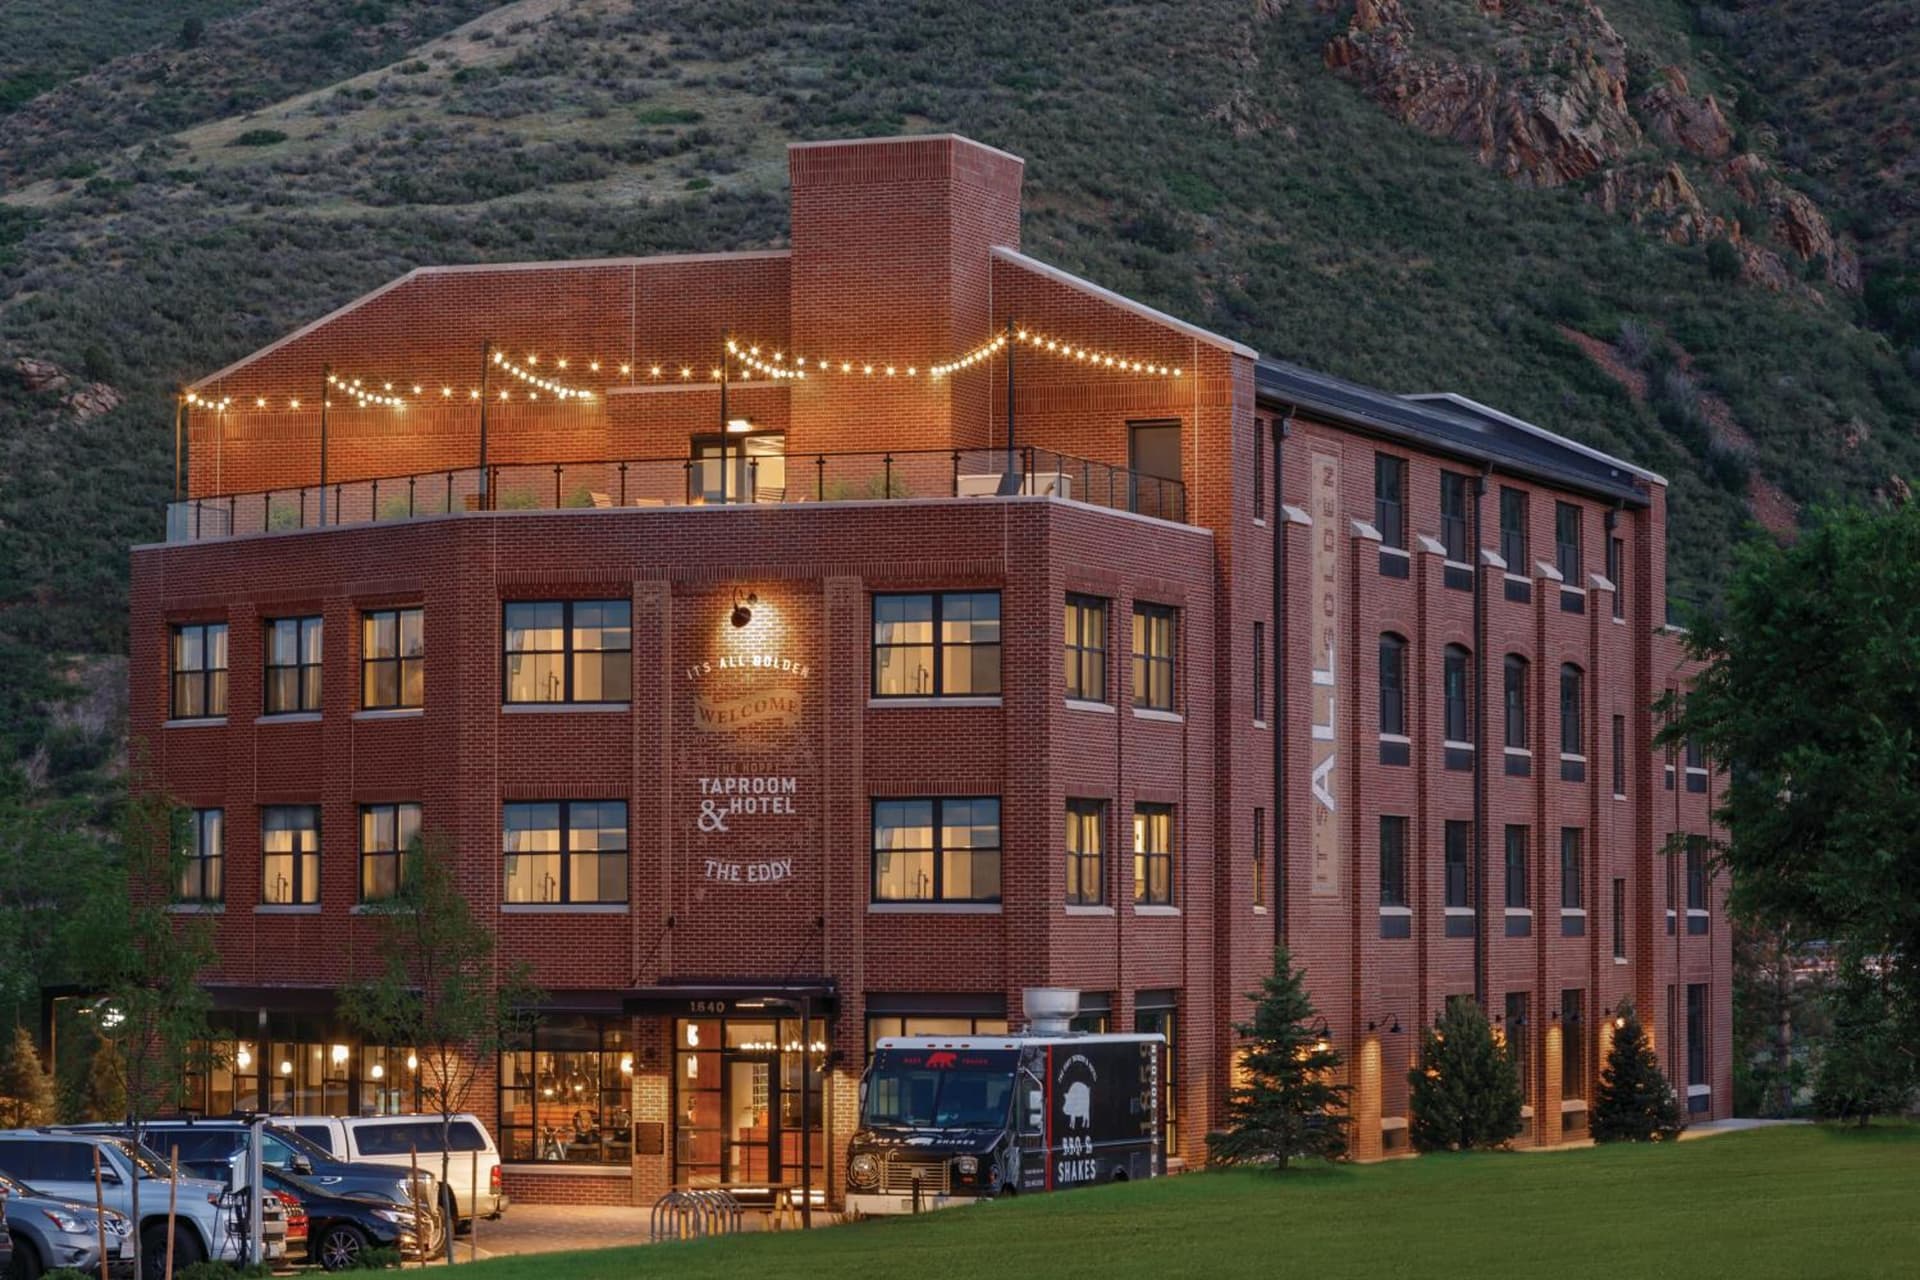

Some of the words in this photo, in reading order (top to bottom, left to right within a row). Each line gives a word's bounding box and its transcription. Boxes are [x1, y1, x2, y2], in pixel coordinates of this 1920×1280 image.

[719, 655, 745, 669] ALL
[698, 696, 799, 724] WELCOME
[1311, 639, 1335, 812] ALL
[699, 777, 797, 794] TAPROOM
[697, 799, 729, 832] &
[730, 797, 796, 814] HOTEL
[704, 860, 741, 881] THE
[747, 858, 792, 882] EDDY
[1062, 1135, 1083, 1156] BBQ
[1057, 1159, 1097, 1183] SHAKES
